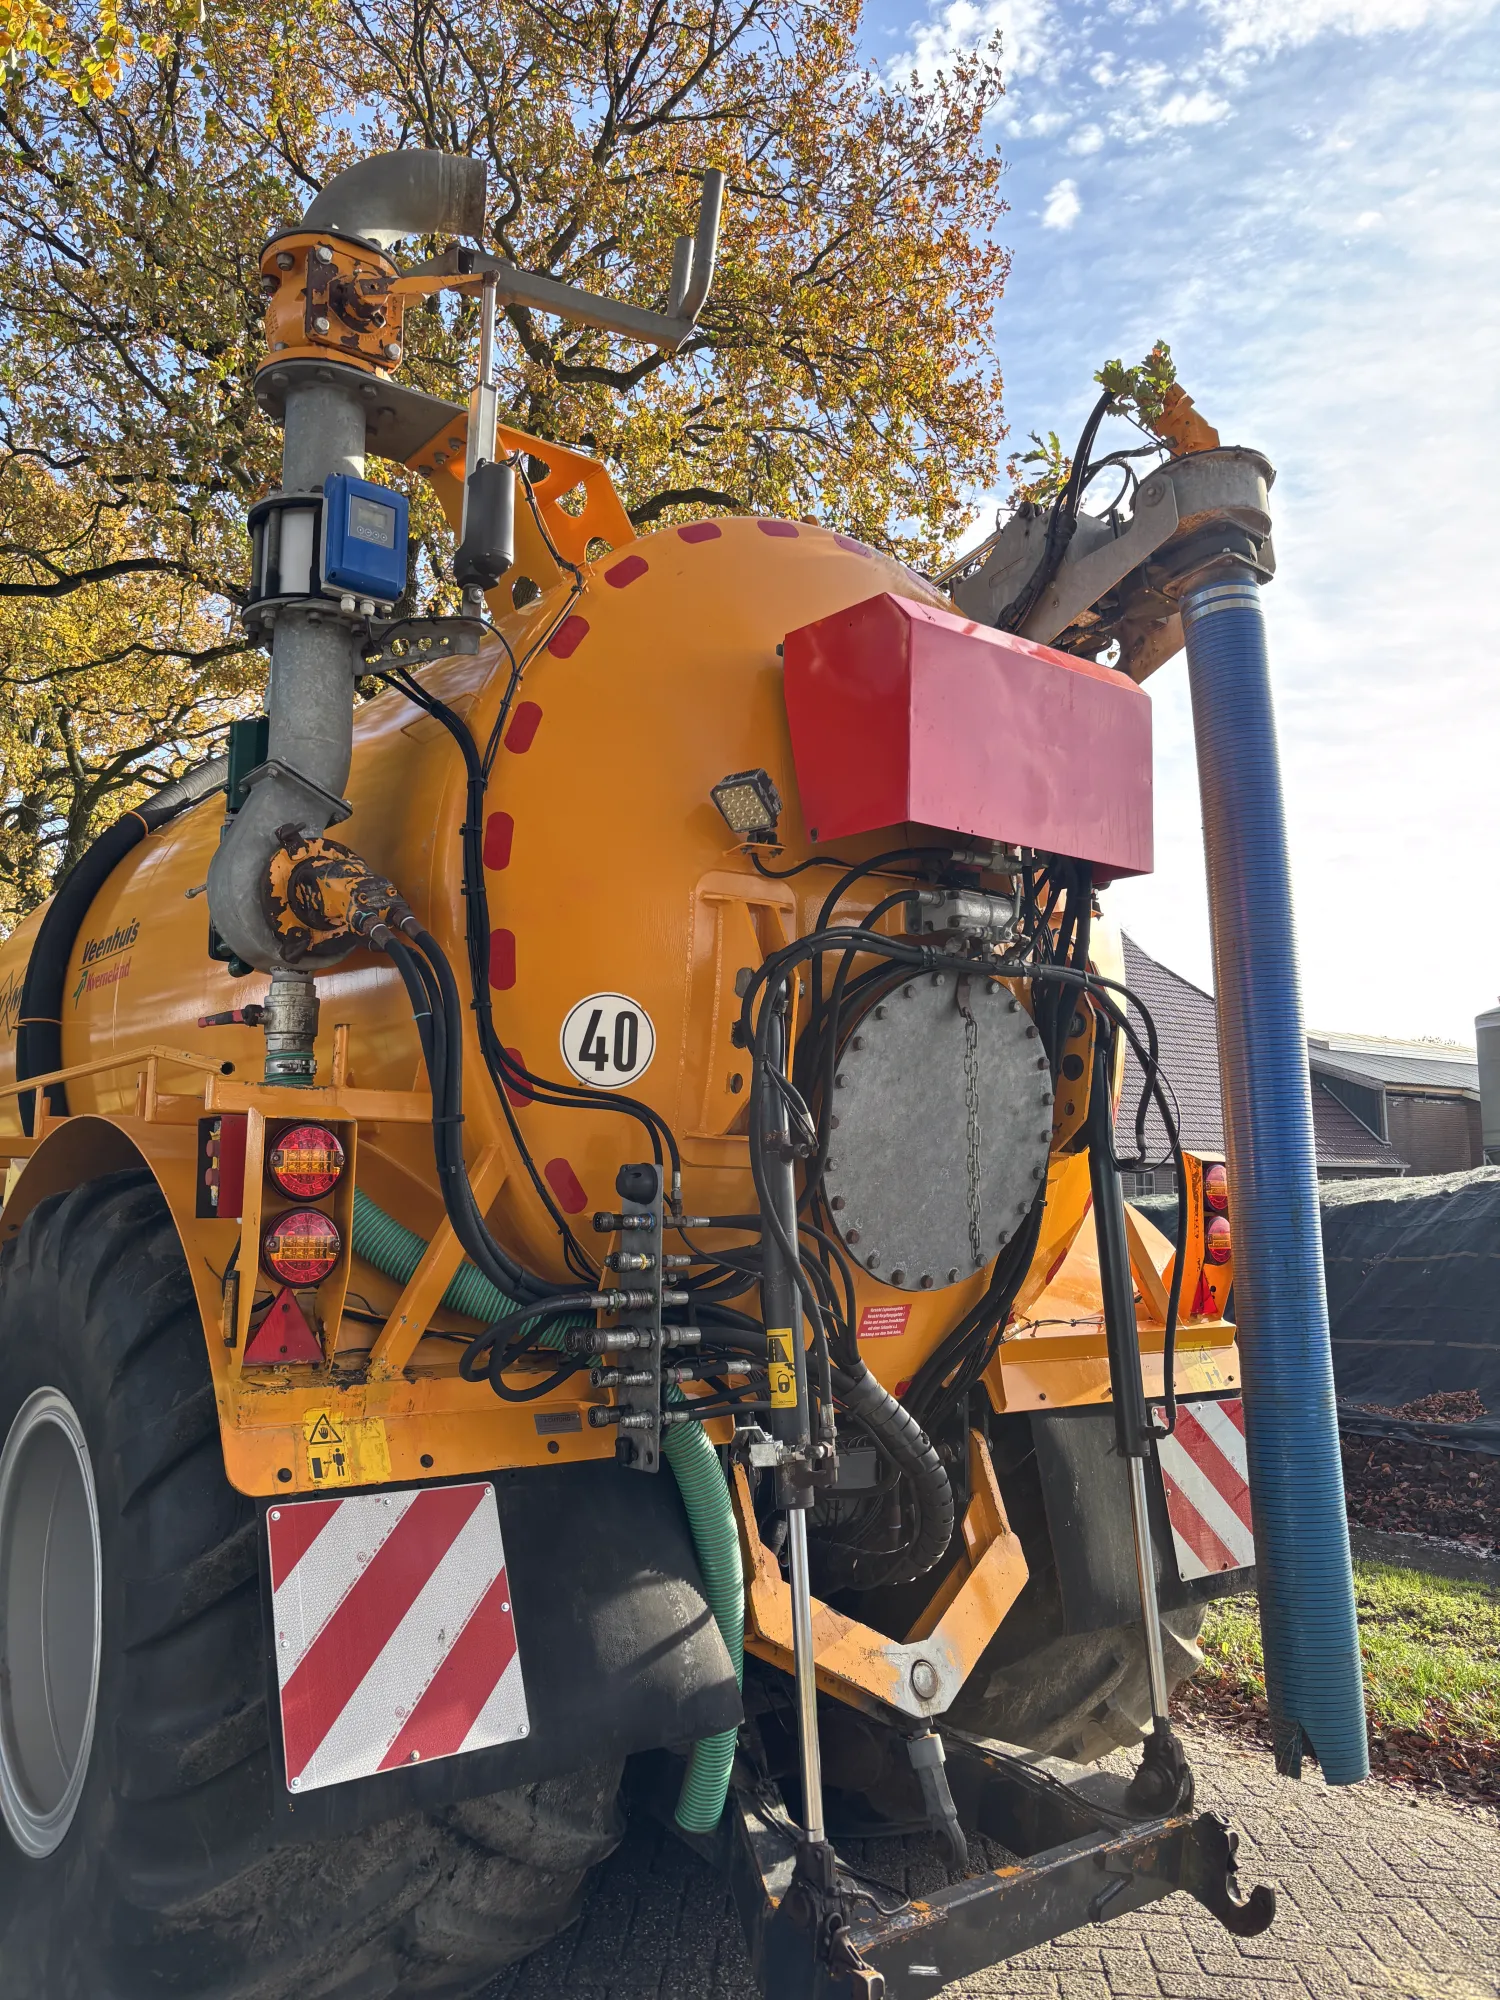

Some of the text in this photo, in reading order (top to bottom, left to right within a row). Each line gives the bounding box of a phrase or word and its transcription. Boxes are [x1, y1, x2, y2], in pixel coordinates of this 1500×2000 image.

[82, 917, 140, 965] Veenhuis
[86, 956, 132, 993] Kverneland
[578, 1009, 639, 1072] 40
